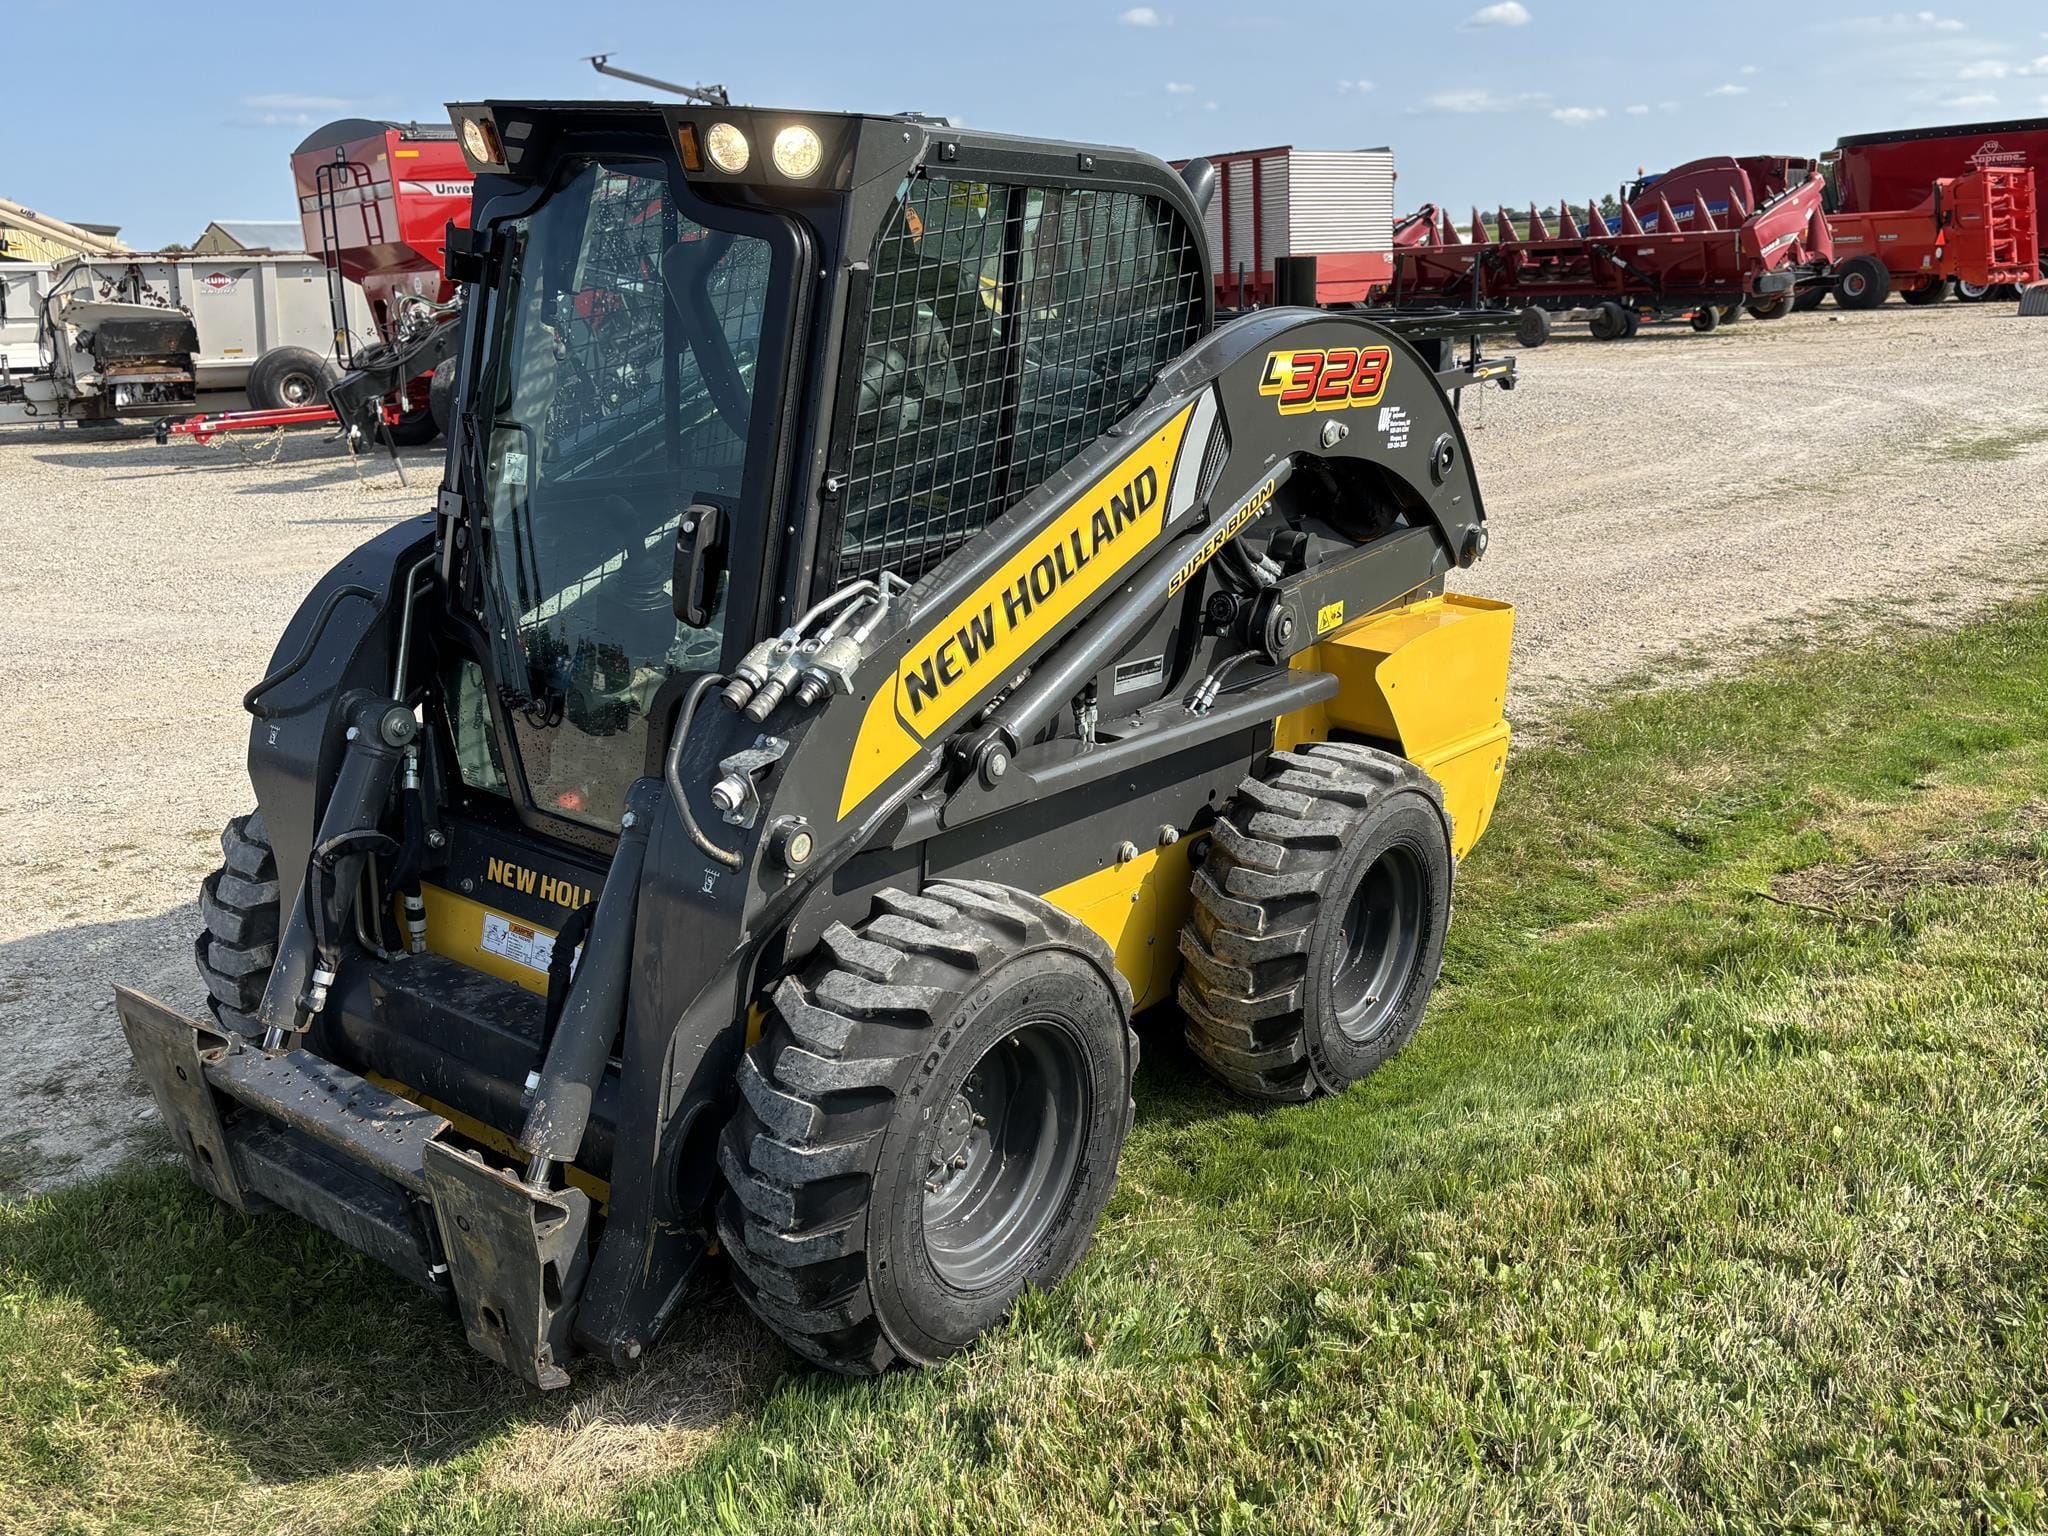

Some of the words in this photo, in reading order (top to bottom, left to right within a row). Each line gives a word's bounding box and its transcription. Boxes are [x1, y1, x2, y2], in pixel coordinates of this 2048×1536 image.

[1965, 152, 2026, 165] Supreme
[435, 183, 474, 194] Unver
[204, 276, 232, 285] KUHN
[1260, 347, 1390, 408] L328
[1169, 529, 1225, 594] SUPER
[1227, 480, 1273, 536] BOOM
[904, 603, 995, 716] NEW
[1001, 465, 1158, 631] HOLLAND
[487, 856, 537, 895] NEW
[540, 875, 591, 910] HOLL
